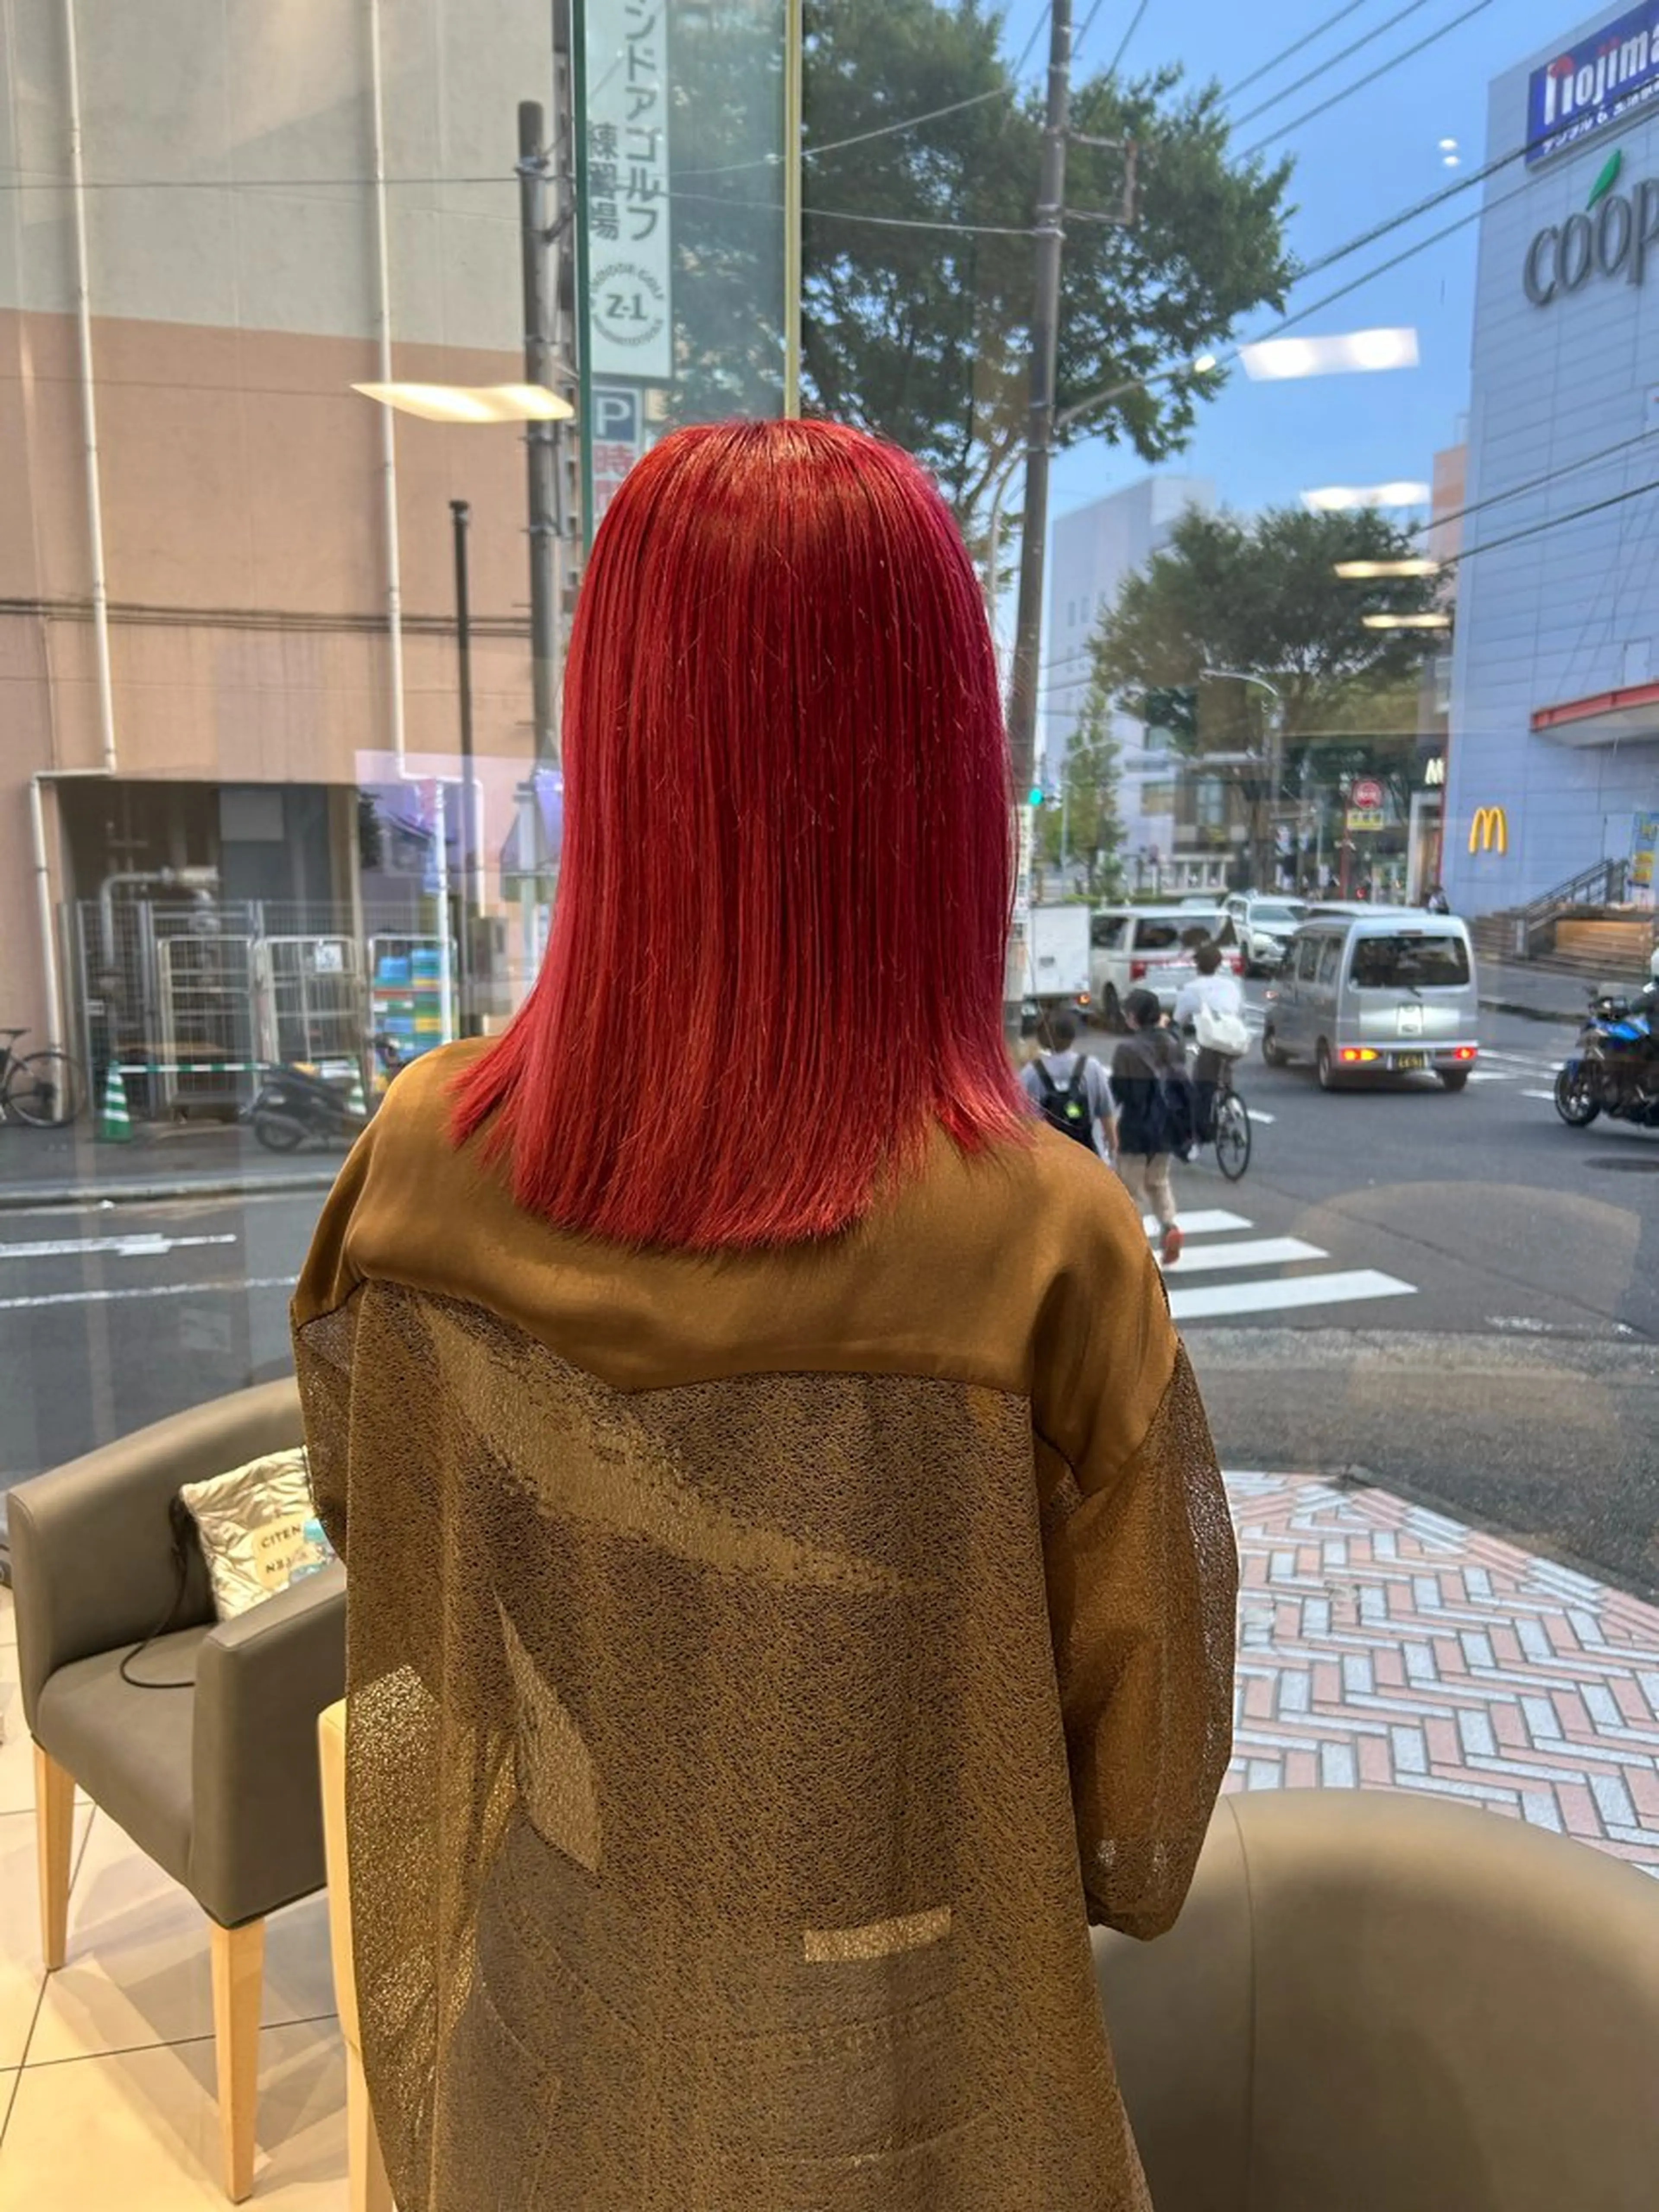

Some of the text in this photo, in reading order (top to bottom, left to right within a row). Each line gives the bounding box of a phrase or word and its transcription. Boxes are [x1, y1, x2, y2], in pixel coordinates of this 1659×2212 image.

[625, 0, 661, 241] ンドアゴルフ
[606, 292, 648, 321] Z-1
[597, 397, 630, 434] P
[261, 1523, 301, 1548] CITEN
